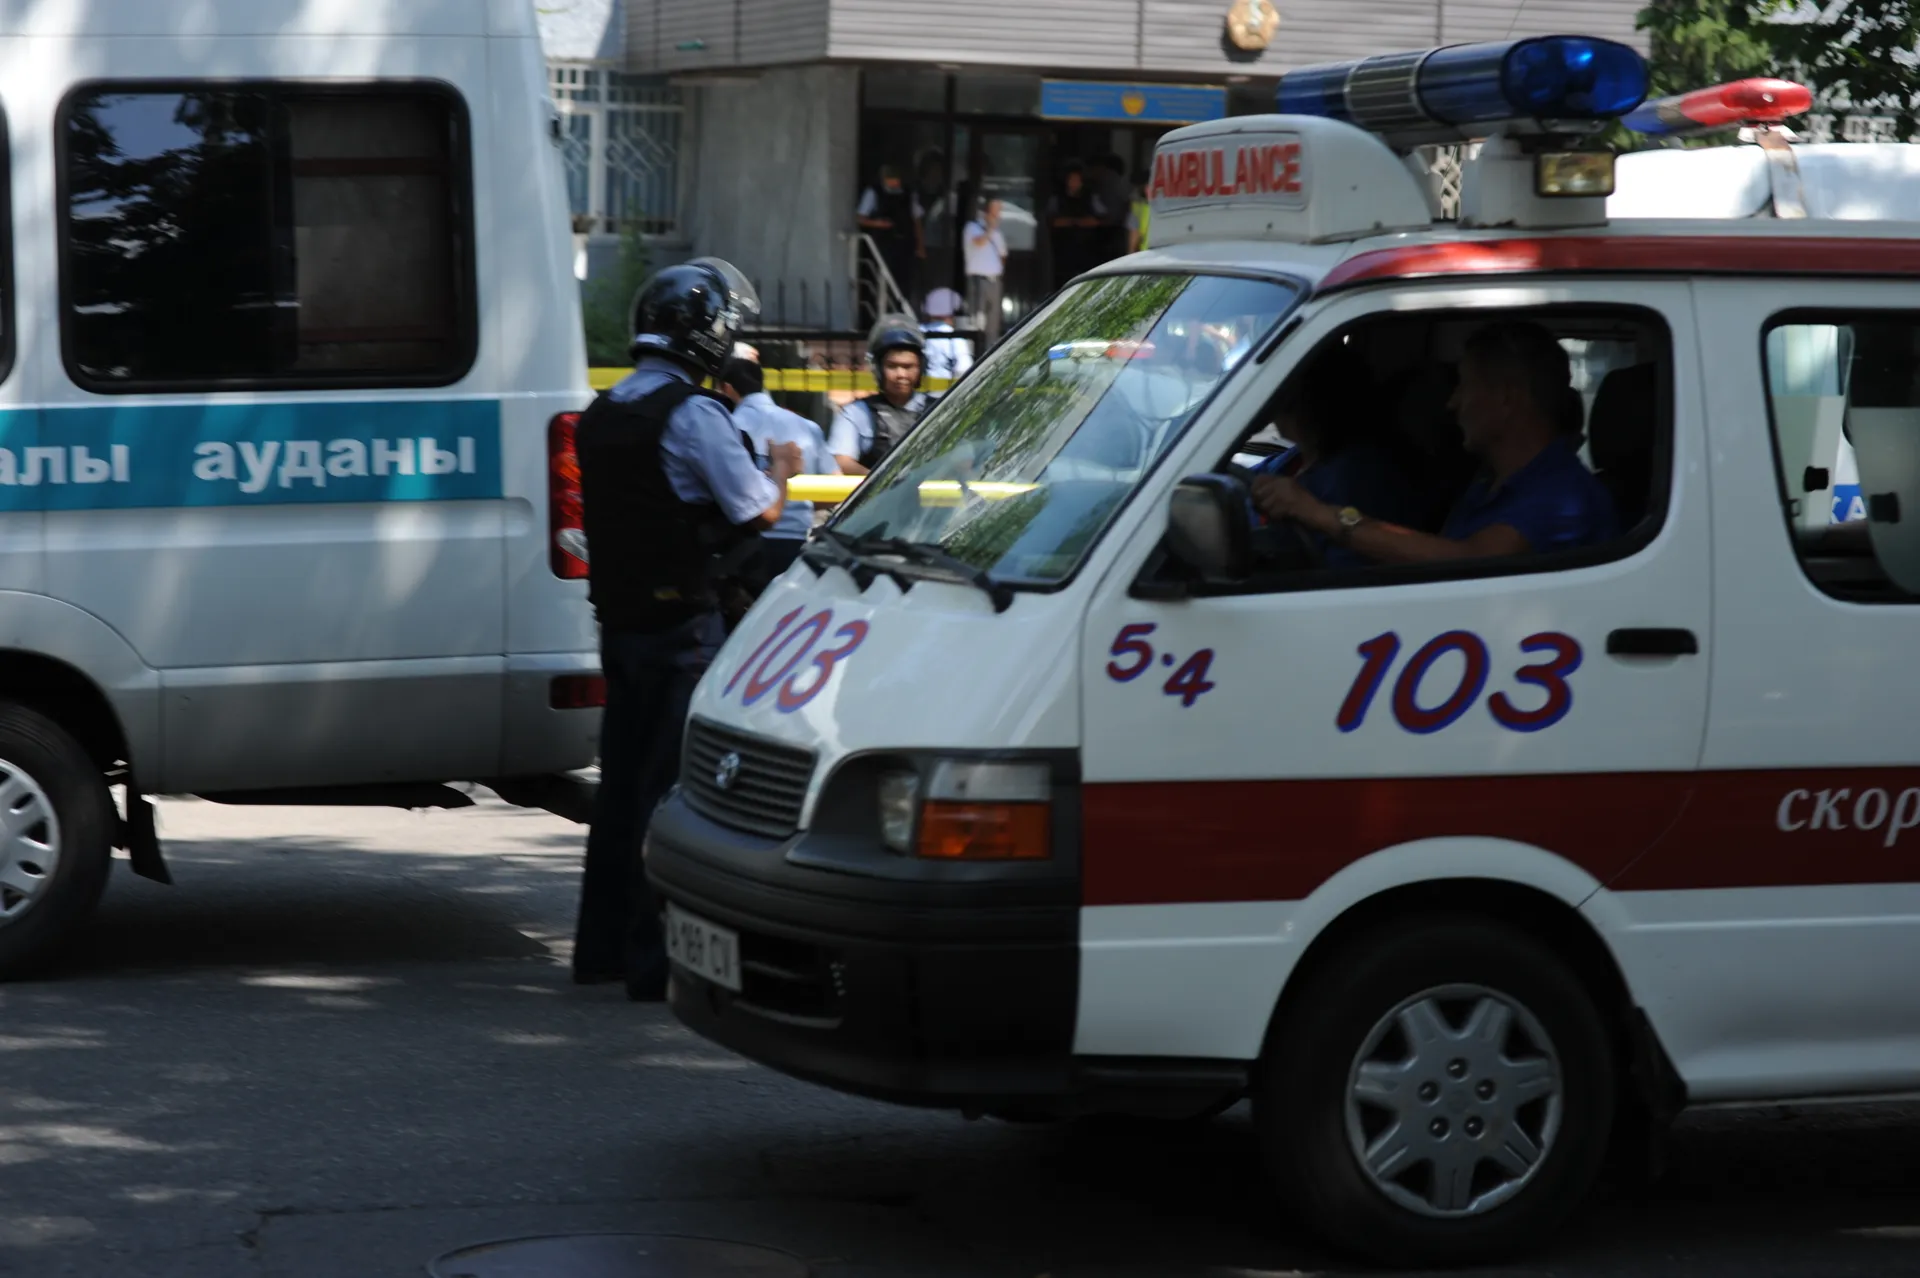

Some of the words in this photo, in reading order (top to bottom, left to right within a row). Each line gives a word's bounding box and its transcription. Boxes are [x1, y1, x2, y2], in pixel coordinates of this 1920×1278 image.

[1151, 143, 1303, 199] AMBULANCE
[192, 436, 477, 494] ауданы
[722, 605, 870, 713] 103
[1335, 630, 1584, 734] 103
